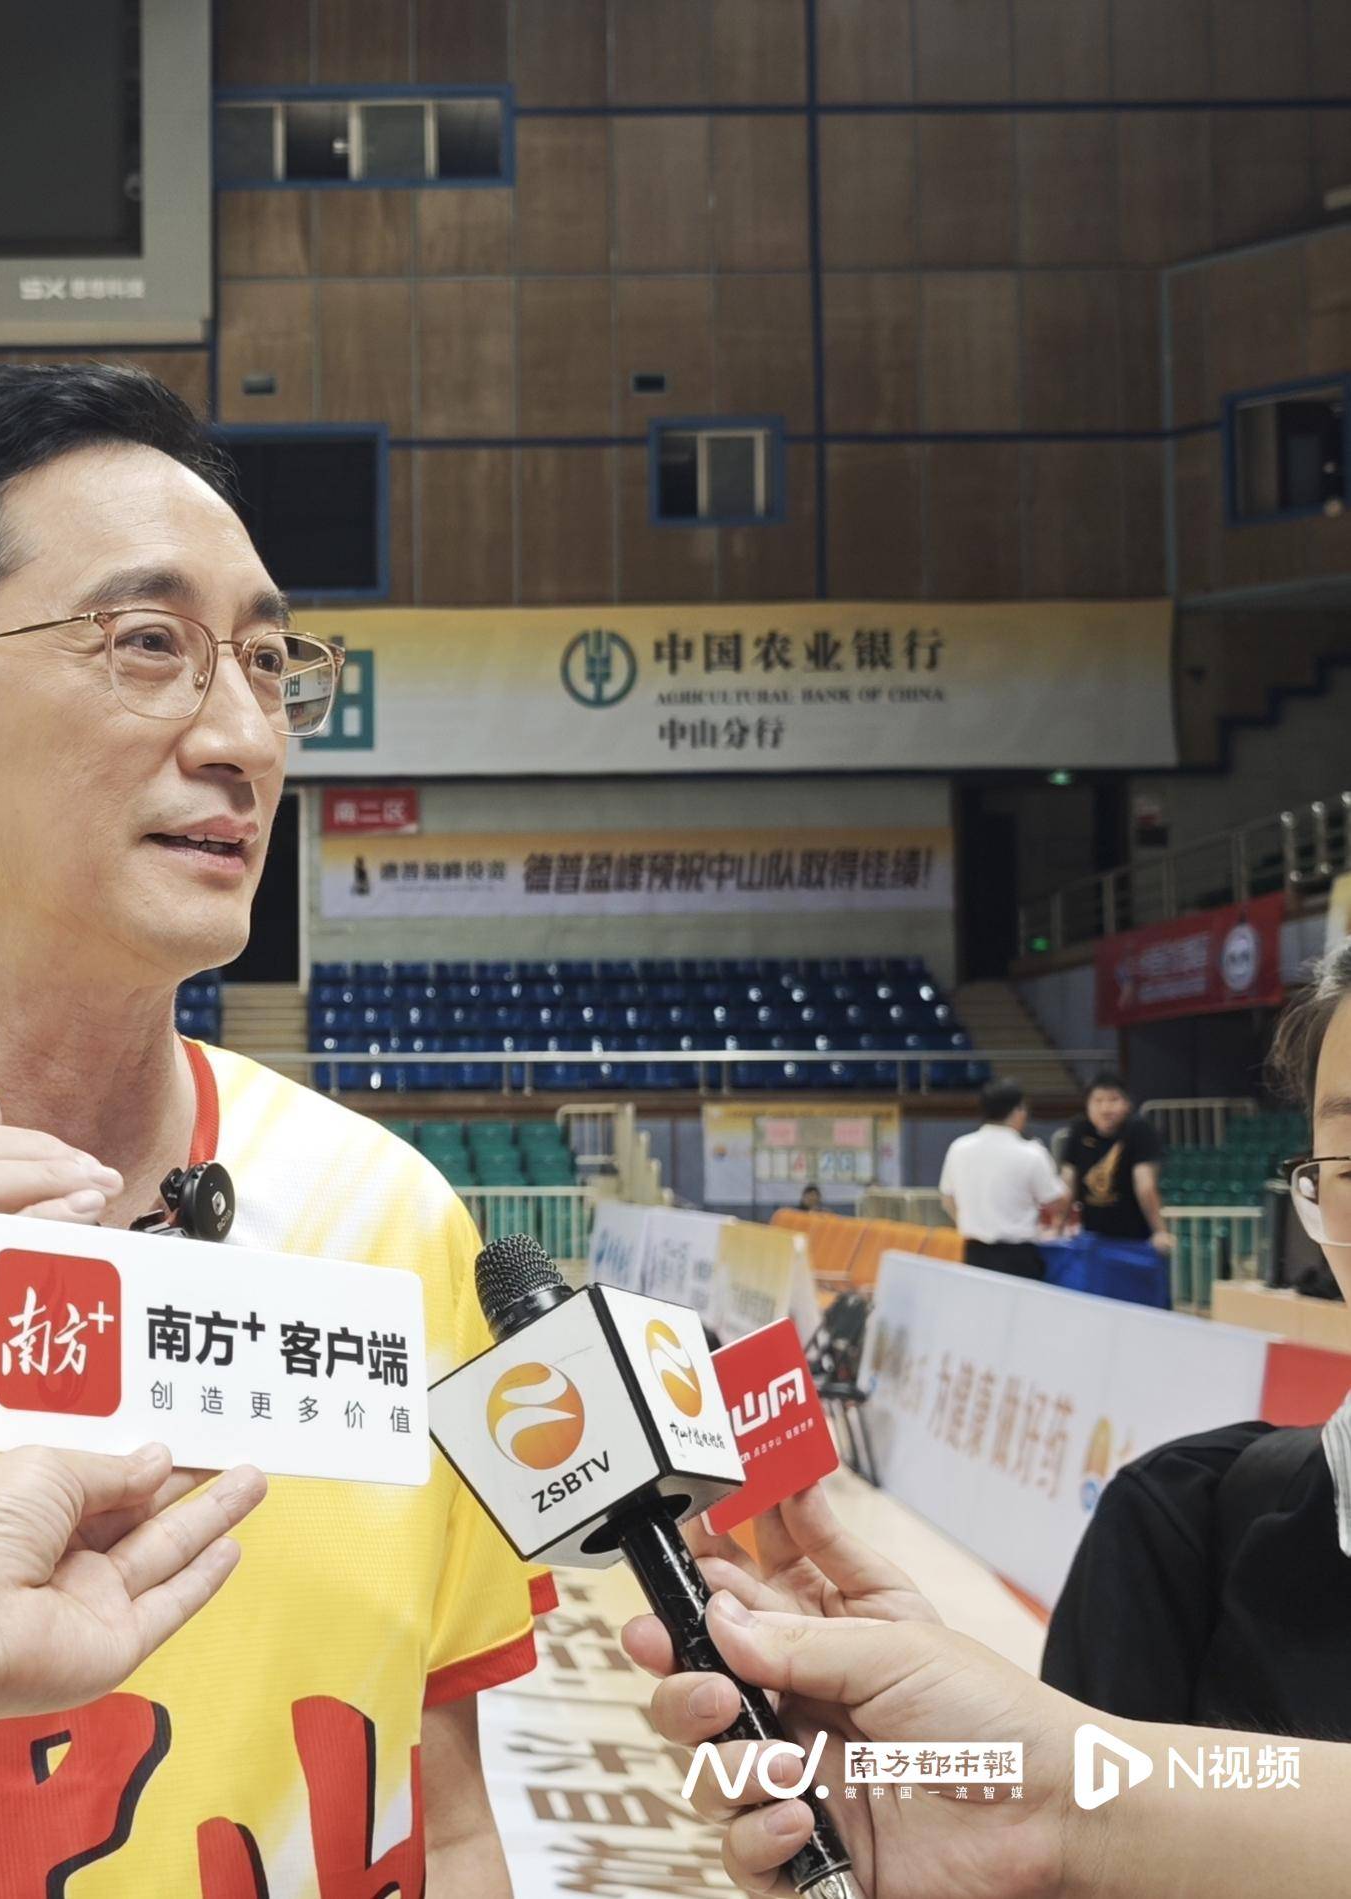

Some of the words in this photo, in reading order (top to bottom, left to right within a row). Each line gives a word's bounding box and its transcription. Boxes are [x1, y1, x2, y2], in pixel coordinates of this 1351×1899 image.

[652, 628, 946, 674] 中国农业银行
[801, 687, 850, 704] BANK
[887, 686, 945, 703] CHINA
[658, 716, 784, 750] 中山分行
[279, 1319, 409, 1388] 客户端
[149, 1380, 413, 1435] 创造更多价值
[531, 1451, 613, 1514] ZSBTV
